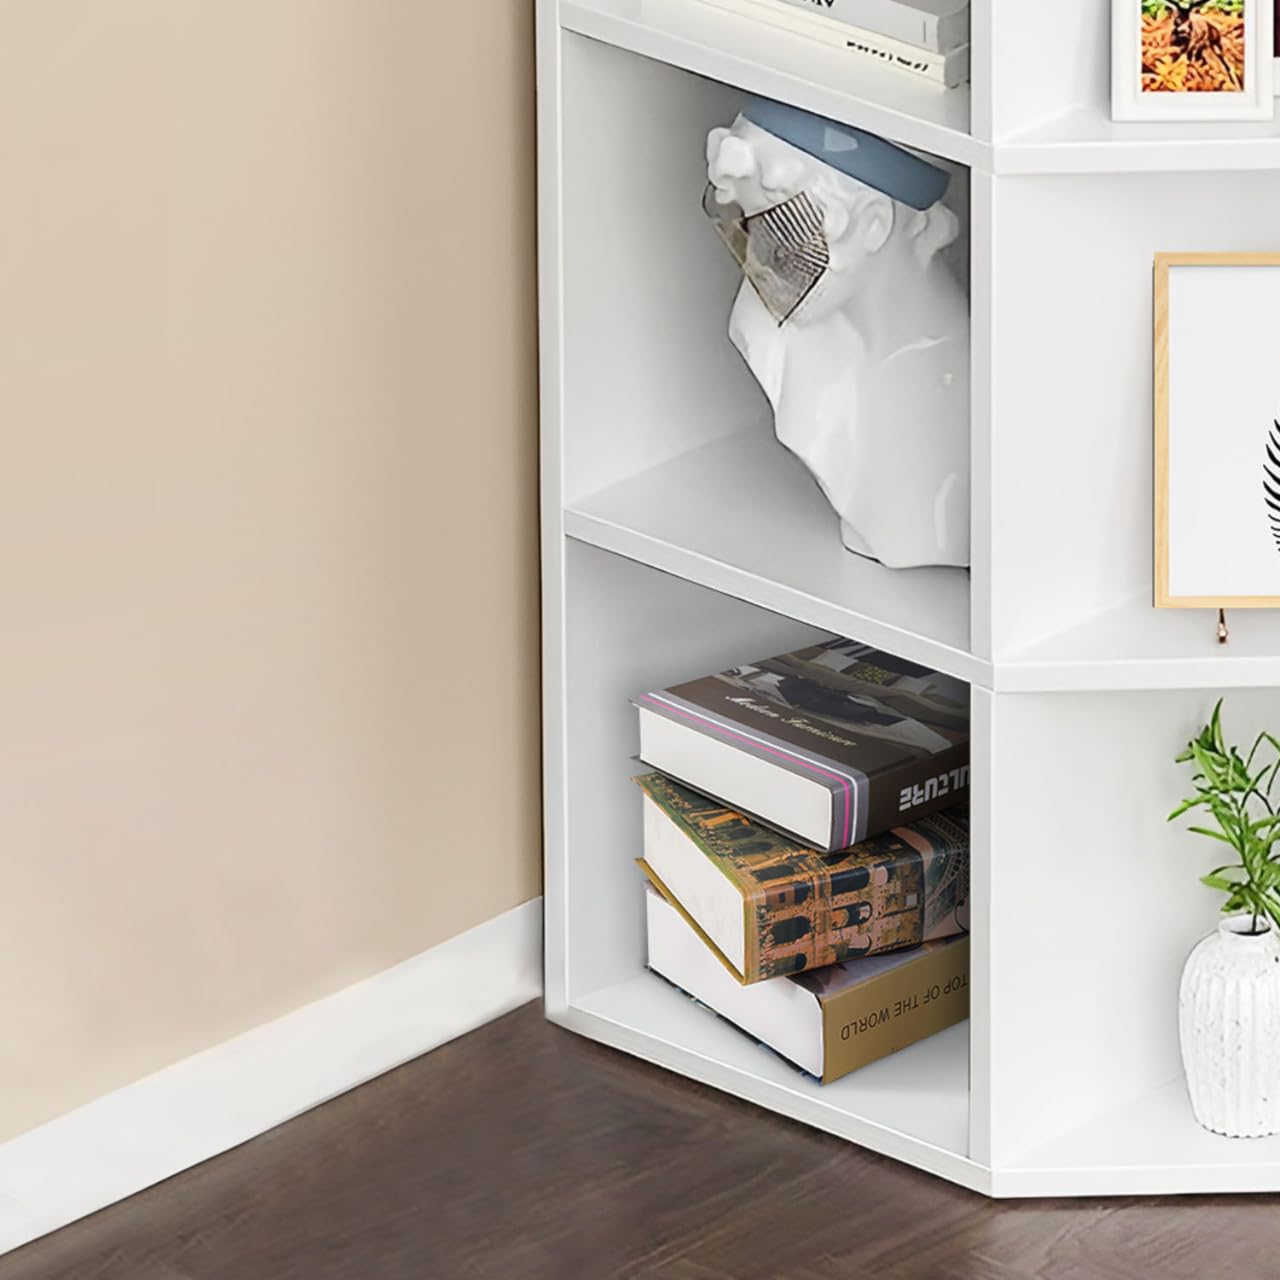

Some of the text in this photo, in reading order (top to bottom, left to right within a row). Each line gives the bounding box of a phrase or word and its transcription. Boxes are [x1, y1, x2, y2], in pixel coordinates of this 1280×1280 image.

[840, 973, 969, 1041] TOP OF THE WORLD
